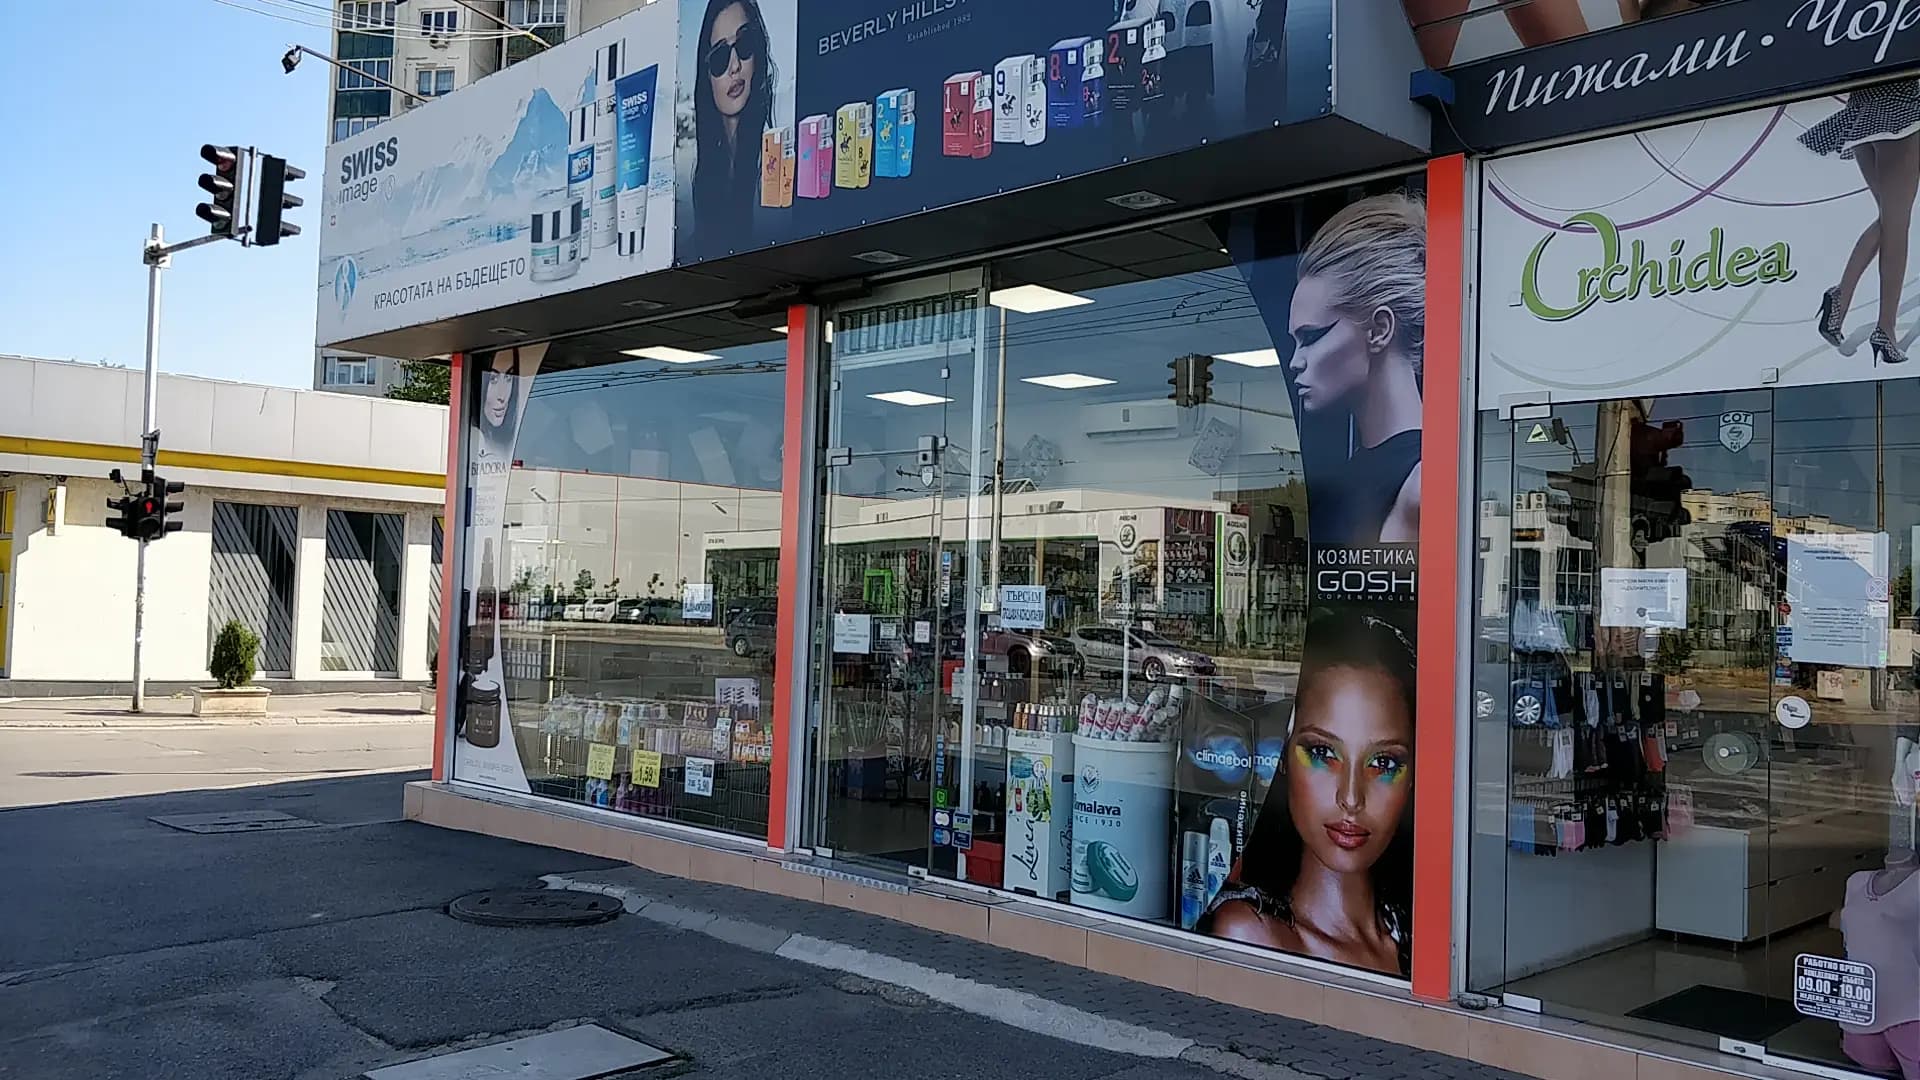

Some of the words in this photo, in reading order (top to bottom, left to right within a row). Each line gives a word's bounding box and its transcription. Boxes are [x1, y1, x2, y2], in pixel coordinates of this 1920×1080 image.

[818, 10, 898, 56] BEVERLY
[1107, 32, 1120, 64] 2
[1050, 53, 1060, 81] 8
[1485, 28, 1751, 117] Пижами
[996, 70, 1006, 97] 9
[621, 91, 648, 110] SWISS
[877, 103, 884, 119] 2
[944, 86, 951, 113] 1
[1026, 103, 1032, 119] 9
[838, 117, 844, 131] 8
[858, 147, 864, 159] 8
[899, 136, 906, 148] 2
[340, 136, 398, 185] SWISS
[338, 176, 378, 205] image
[1521, 211, 1797, 322] Orchidea
[373, 280, 434, 311] КРАСОТАТА
[436, 276, 453, 296] НА
[455, 257, 526, 291] БЪДЕЩЕТО
[1317, 549, 1416, 565] КОЗМЕТИКА
[1317, 570, 1415, 593] GOSH
[1095, 819, 1121, 828] 1930
[1803, 957, 1838, 970] РАБОТНО
[1798, 975, 1831, 995] 09.00
[1839, 983, 1871, 1002] 19.00
